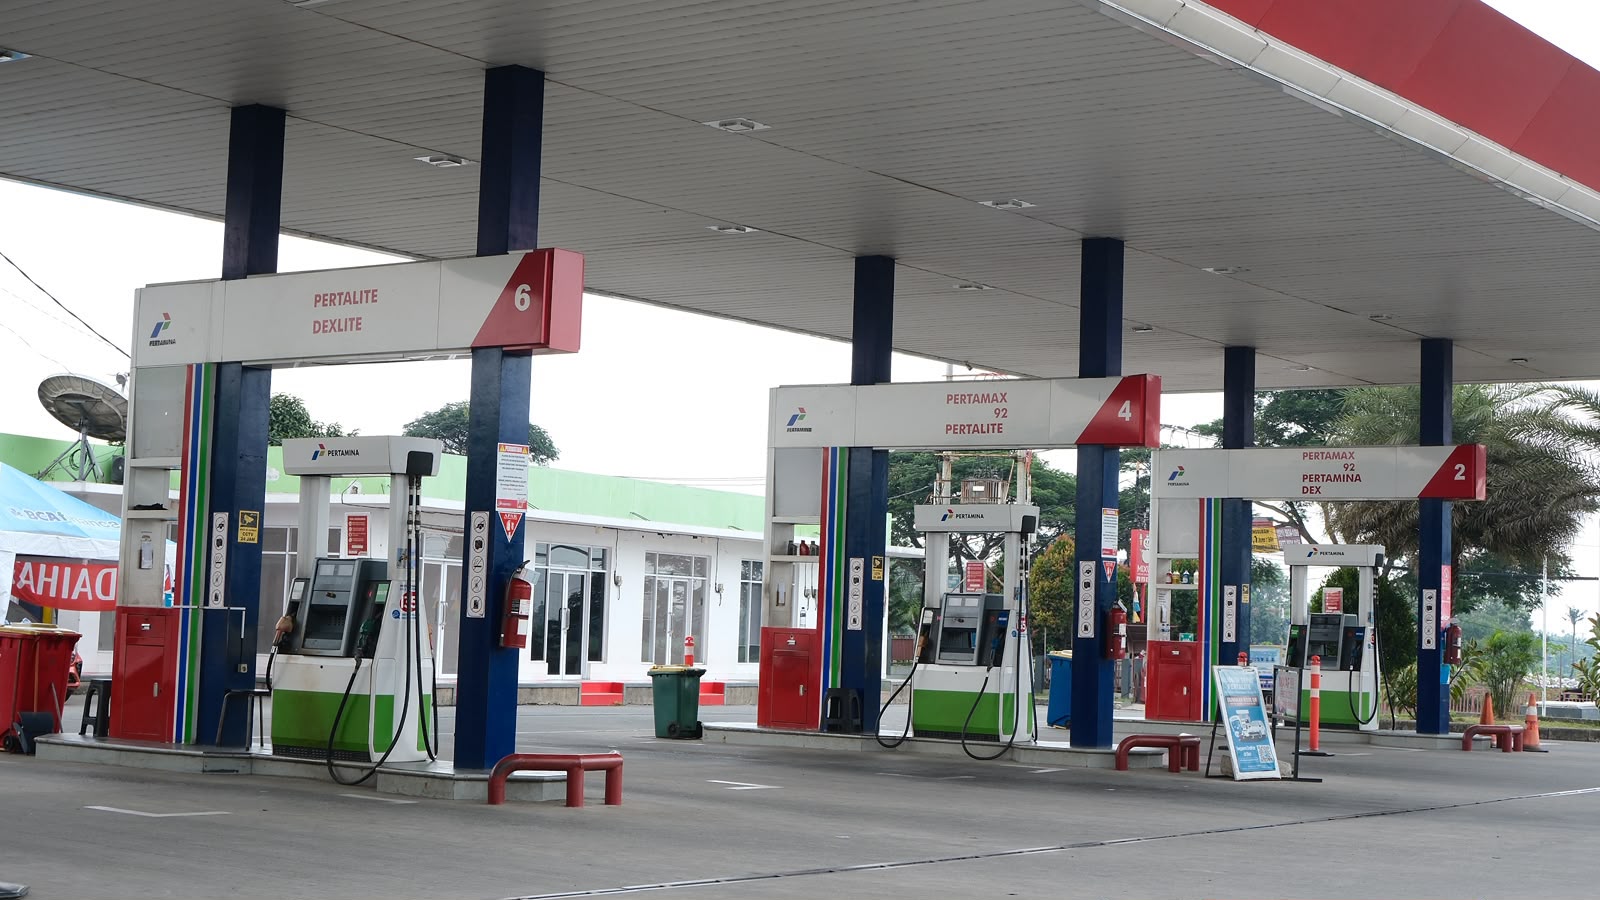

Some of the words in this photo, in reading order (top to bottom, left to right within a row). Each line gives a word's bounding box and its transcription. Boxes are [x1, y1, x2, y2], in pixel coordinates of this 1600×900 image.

[313, 289, 378, 308] PERTALITE
[514, 283, 532, 312] 6
[312, 316, 363, 335] DEXLITE
[946, 392, 1008, 405] PERTAMAX
[993, 407, 1008, 419] 92
[1117, 399, 1132, 422] 4
[945, 422, 1004, 435] PERTALITE
[327, 449, 360, 457] PERTAMINA
[1302, 451, 1355, 461] PERTAMAX
[1343, 462, 1356, 472] 92
[1454, 463, 1466, 481] 2
[1302, 473, 1362, 483] PERTAMINA
[1302, 485, 1322, 495] DEX
